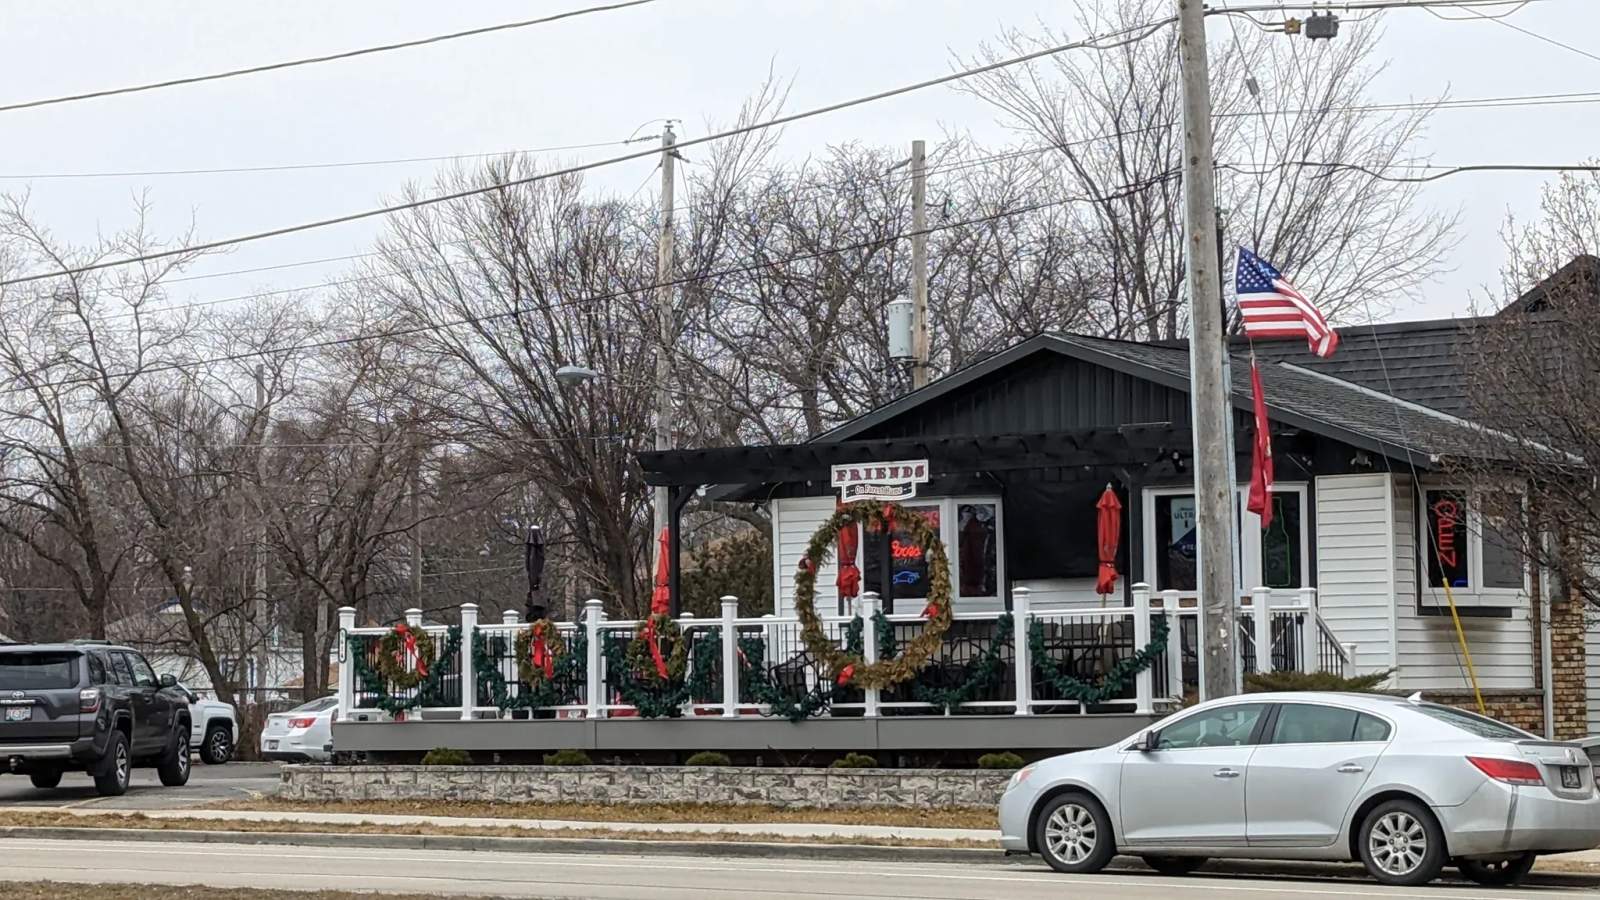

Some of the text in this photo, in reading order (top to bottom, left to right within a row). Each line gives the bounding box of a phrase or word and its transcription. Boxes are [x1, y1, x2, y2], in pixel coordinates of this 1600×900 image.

[835, 465, 925, 481] FRIENDS
[855, 484, 903, 496] On Forest Home
